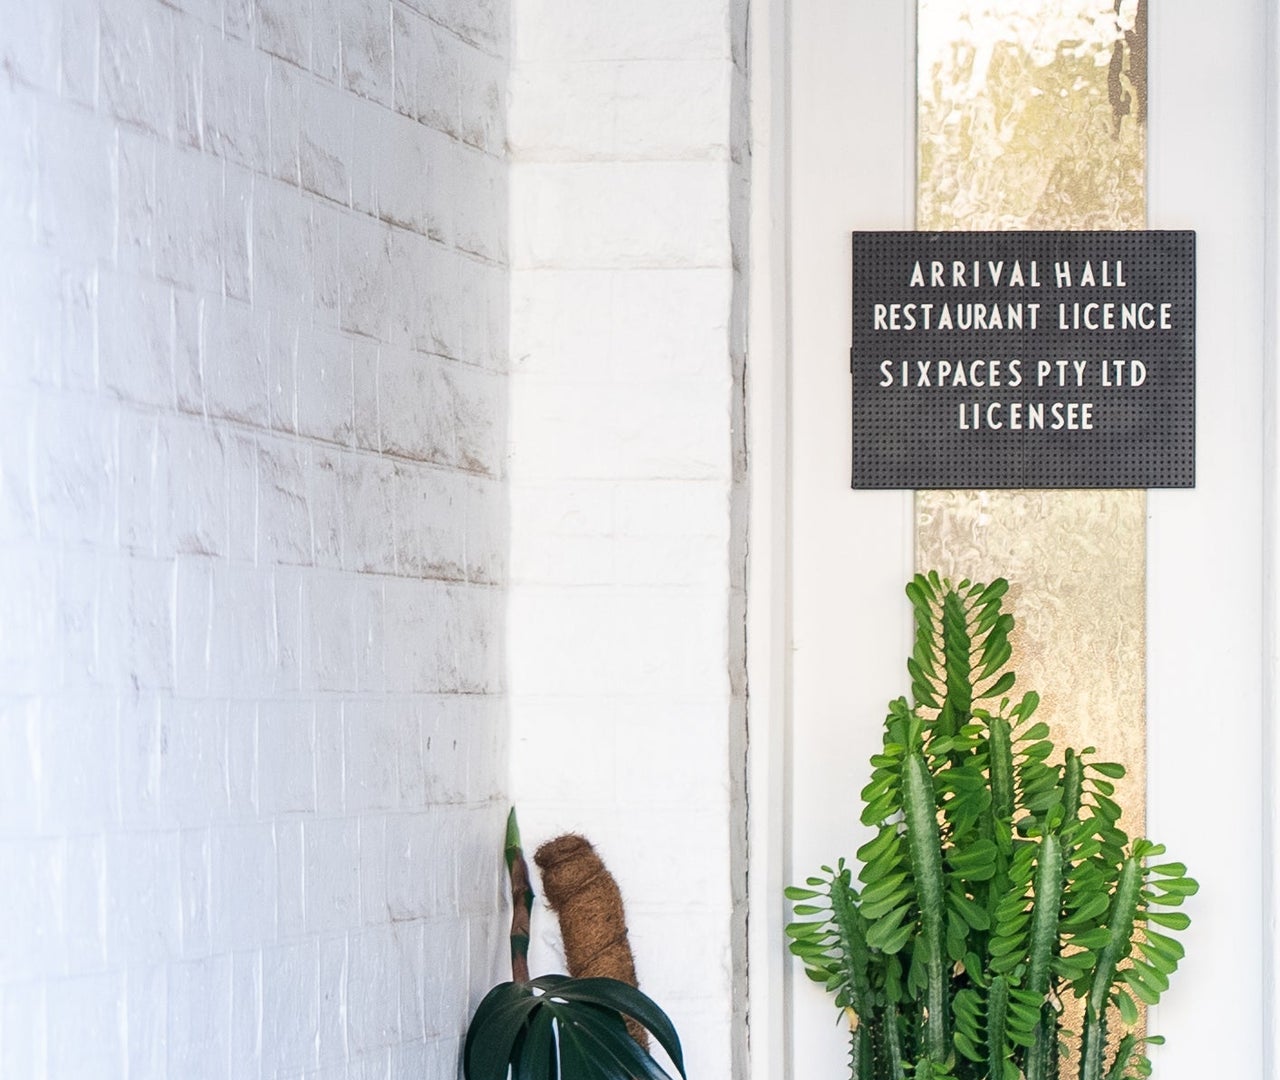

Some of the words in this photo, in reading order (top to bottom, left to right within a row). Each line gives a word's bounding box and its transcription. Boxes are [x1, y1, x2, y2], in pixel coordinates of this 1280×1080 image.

[910, 260, 1041, 288] ARRIVAL
[1054, 260, 1126, 289] HALL
[874, 302, 1041, 331] RESTAURANT
[1059, 302, 1172, 330] LICENCE
[879, 359, 1022, 388] SIXPACES
[1037, 360, 1087, 387] PTY
[1102, 359, 1147, 387] LTD
[959, 402, 1094, 430] LICENSEE
